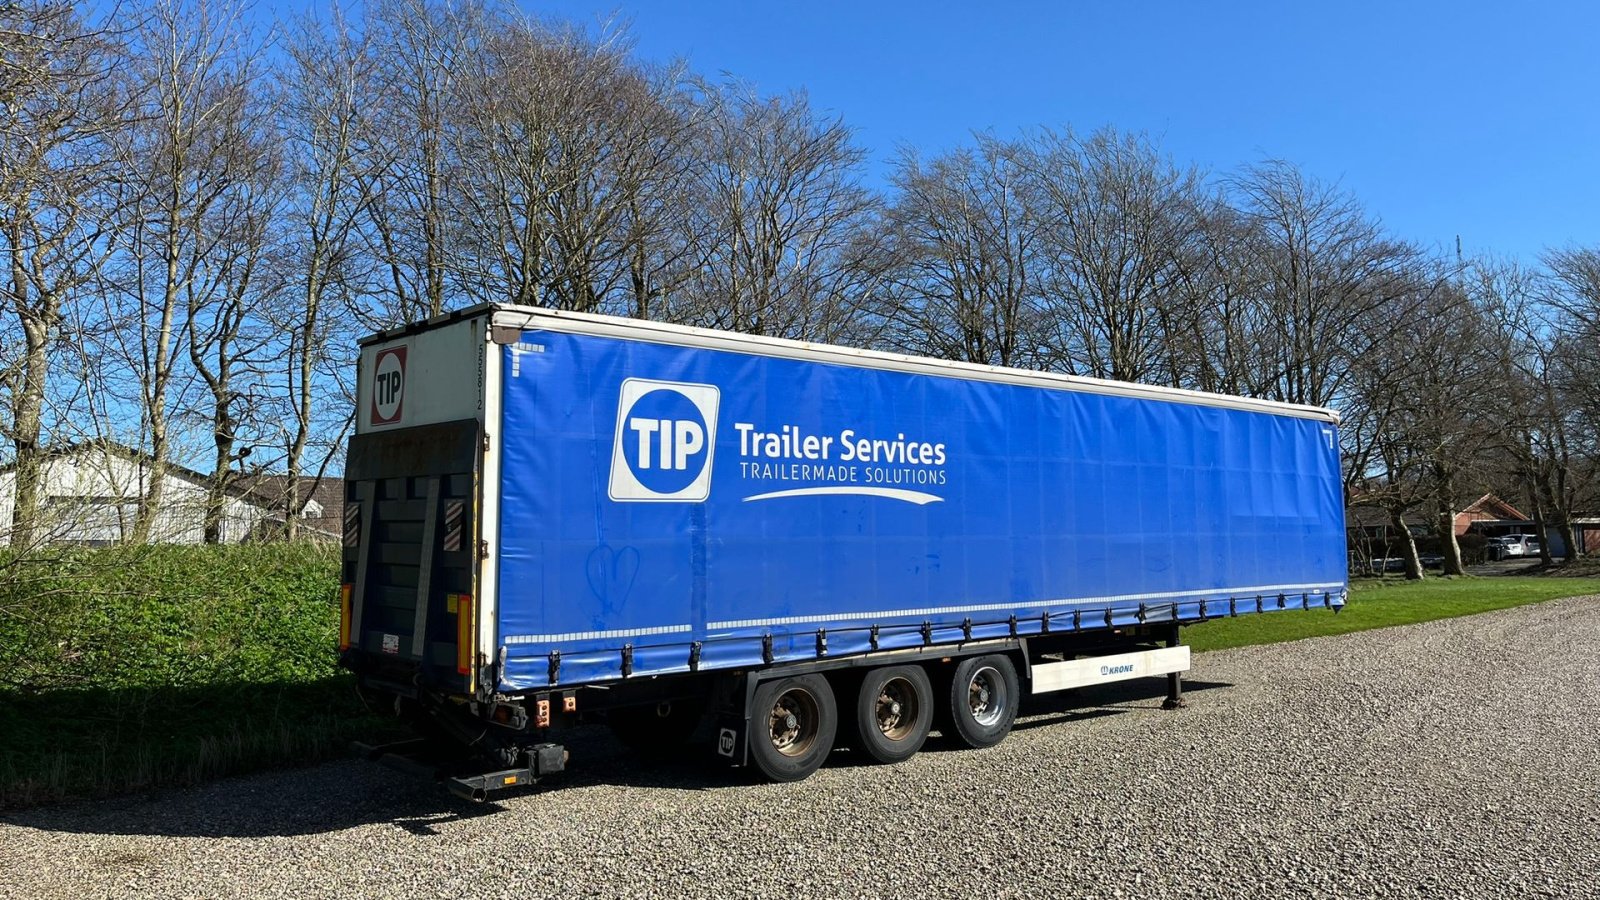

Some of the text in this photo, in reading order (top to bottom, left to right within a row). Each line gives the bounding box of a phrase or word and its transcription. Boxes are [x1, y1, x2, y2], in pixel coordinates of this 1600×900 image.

[377, 370, 401, 405] TIP
[630, 417, 704, 470] TIP
[735, 423, 946, 465] Trailer Services
[740, 462, 946, 485] TRAILERMADE SOLUTIONS
[1109, 664, 1134, 675] KRONE
[721, 736, 733, 750] TIP
